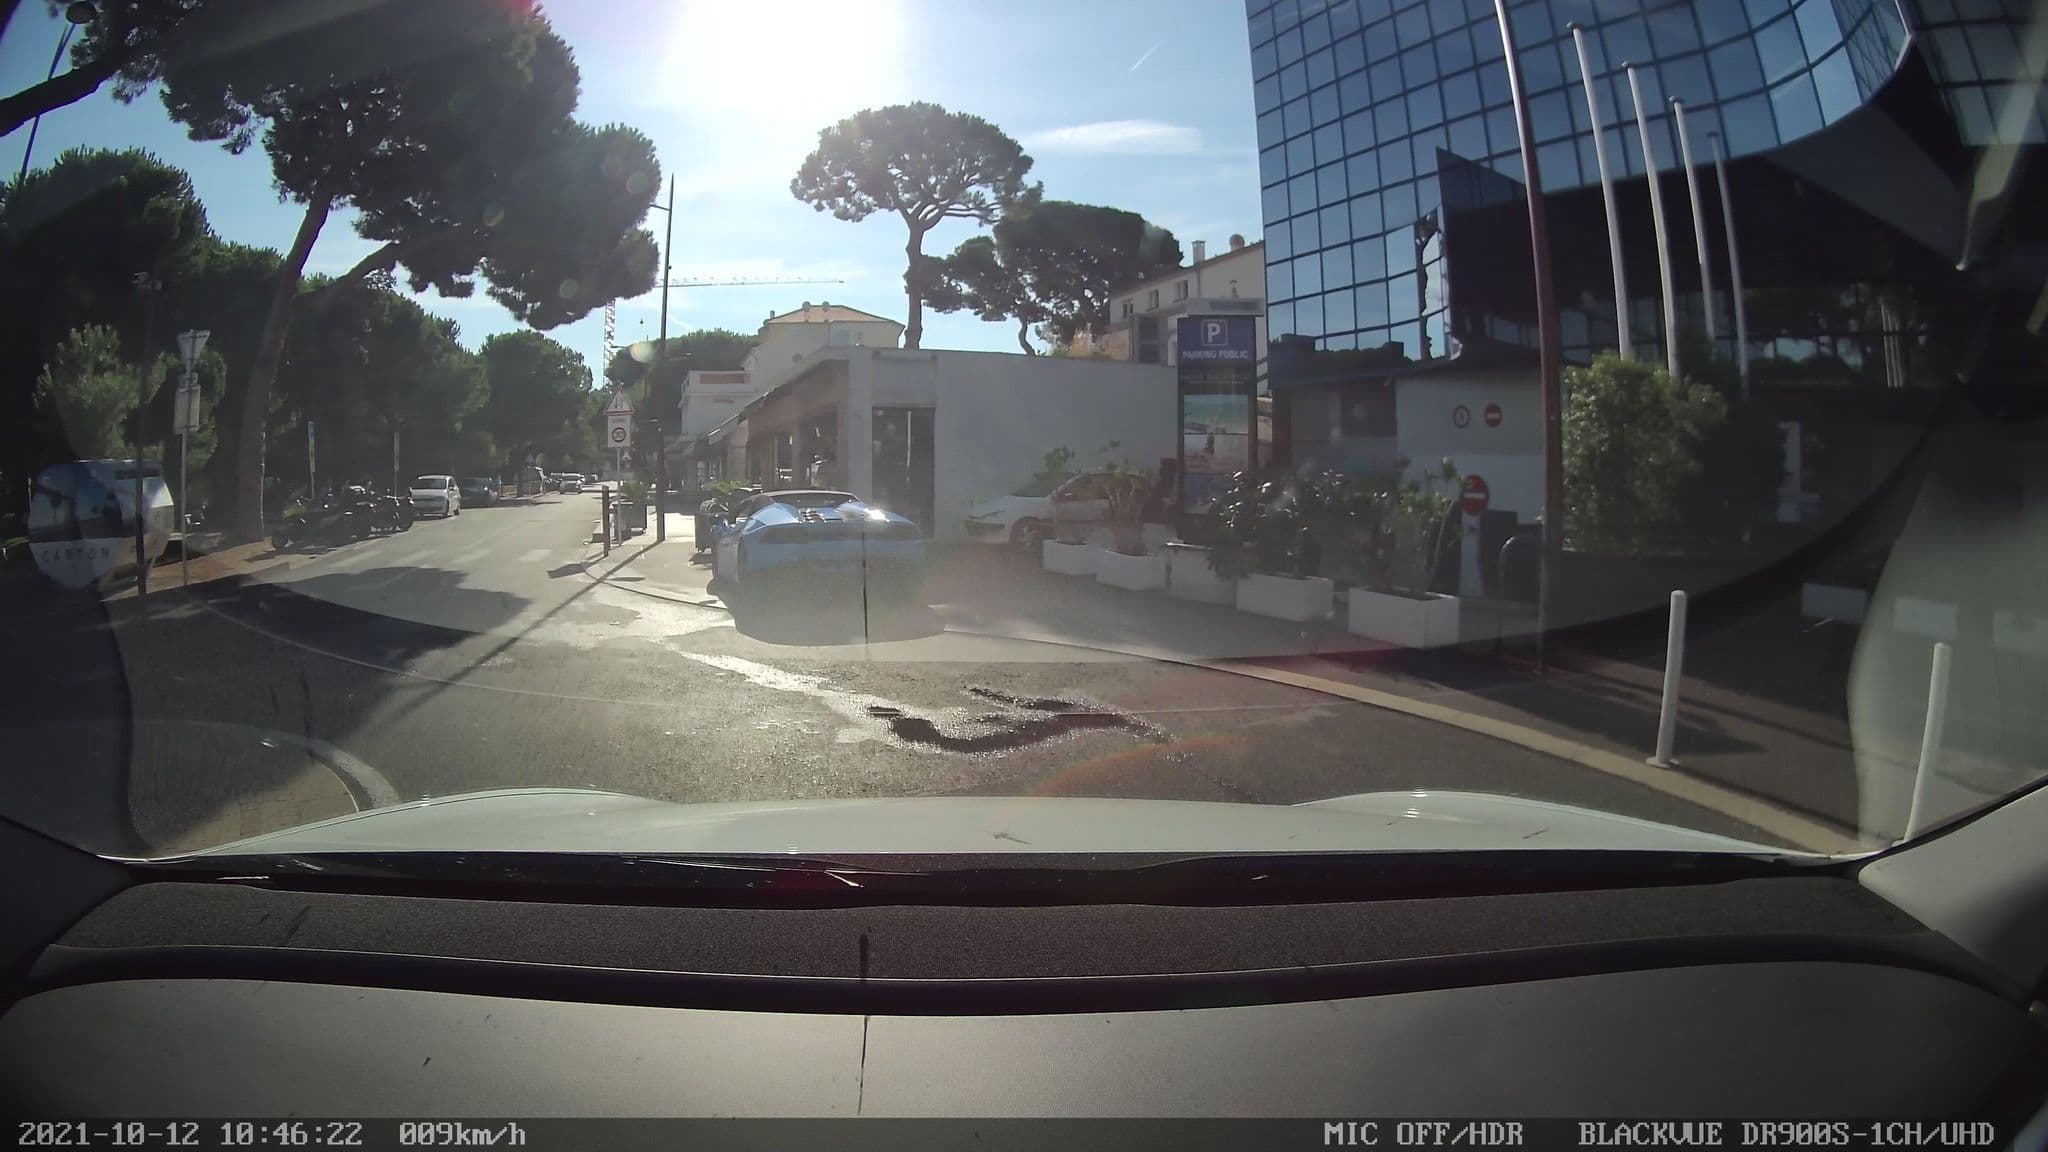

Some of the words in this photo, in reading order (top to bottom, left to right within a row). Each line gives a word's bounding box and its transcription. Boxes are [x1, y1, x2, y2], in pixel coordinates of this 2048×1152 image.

[1207, 322, 1221, 344] P
[1182, 350, 1217, 360] PARKING
[1218, 349, 1249, 360] PUBLIC
